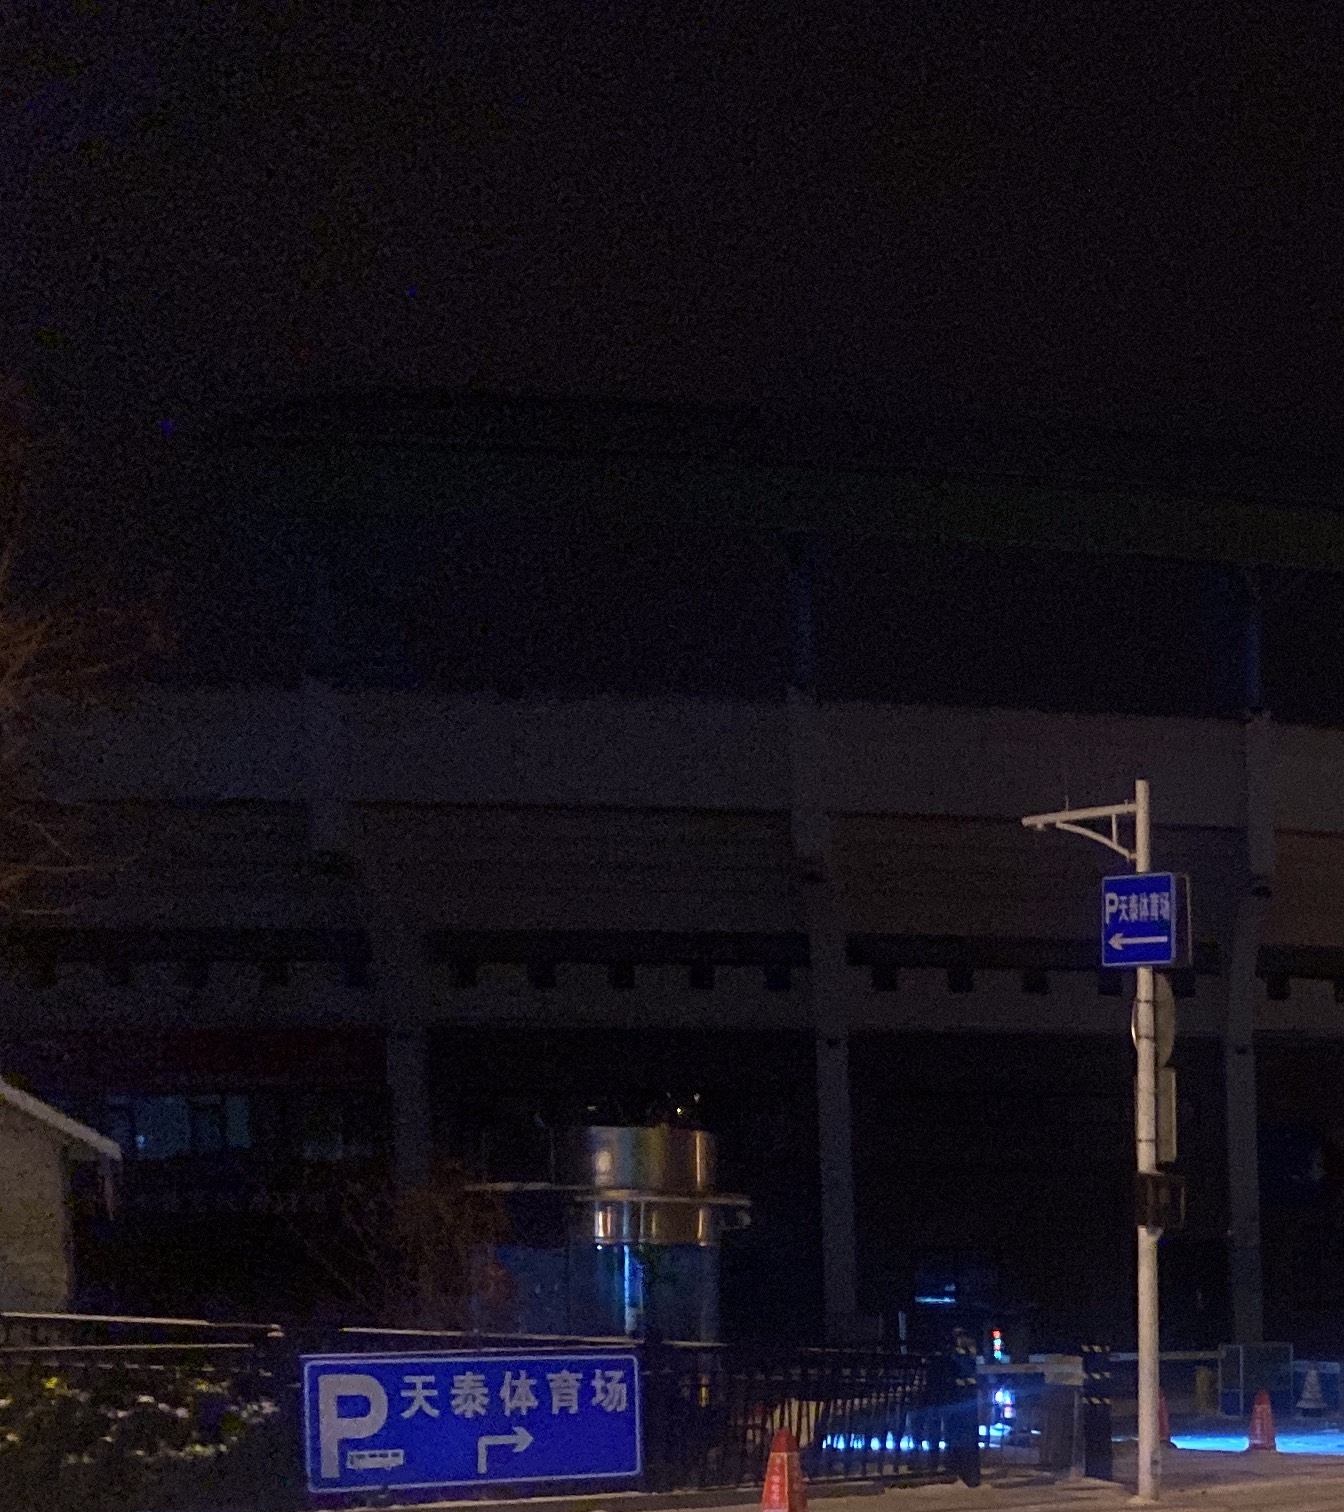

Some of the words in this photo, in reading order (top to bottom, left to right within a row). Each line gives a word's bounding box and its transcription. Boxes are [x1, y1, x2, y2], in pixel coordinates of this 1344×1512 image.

[318, 1374, 388, 1479] P
[400, 1369, 628, 1419] 天泰体育场
